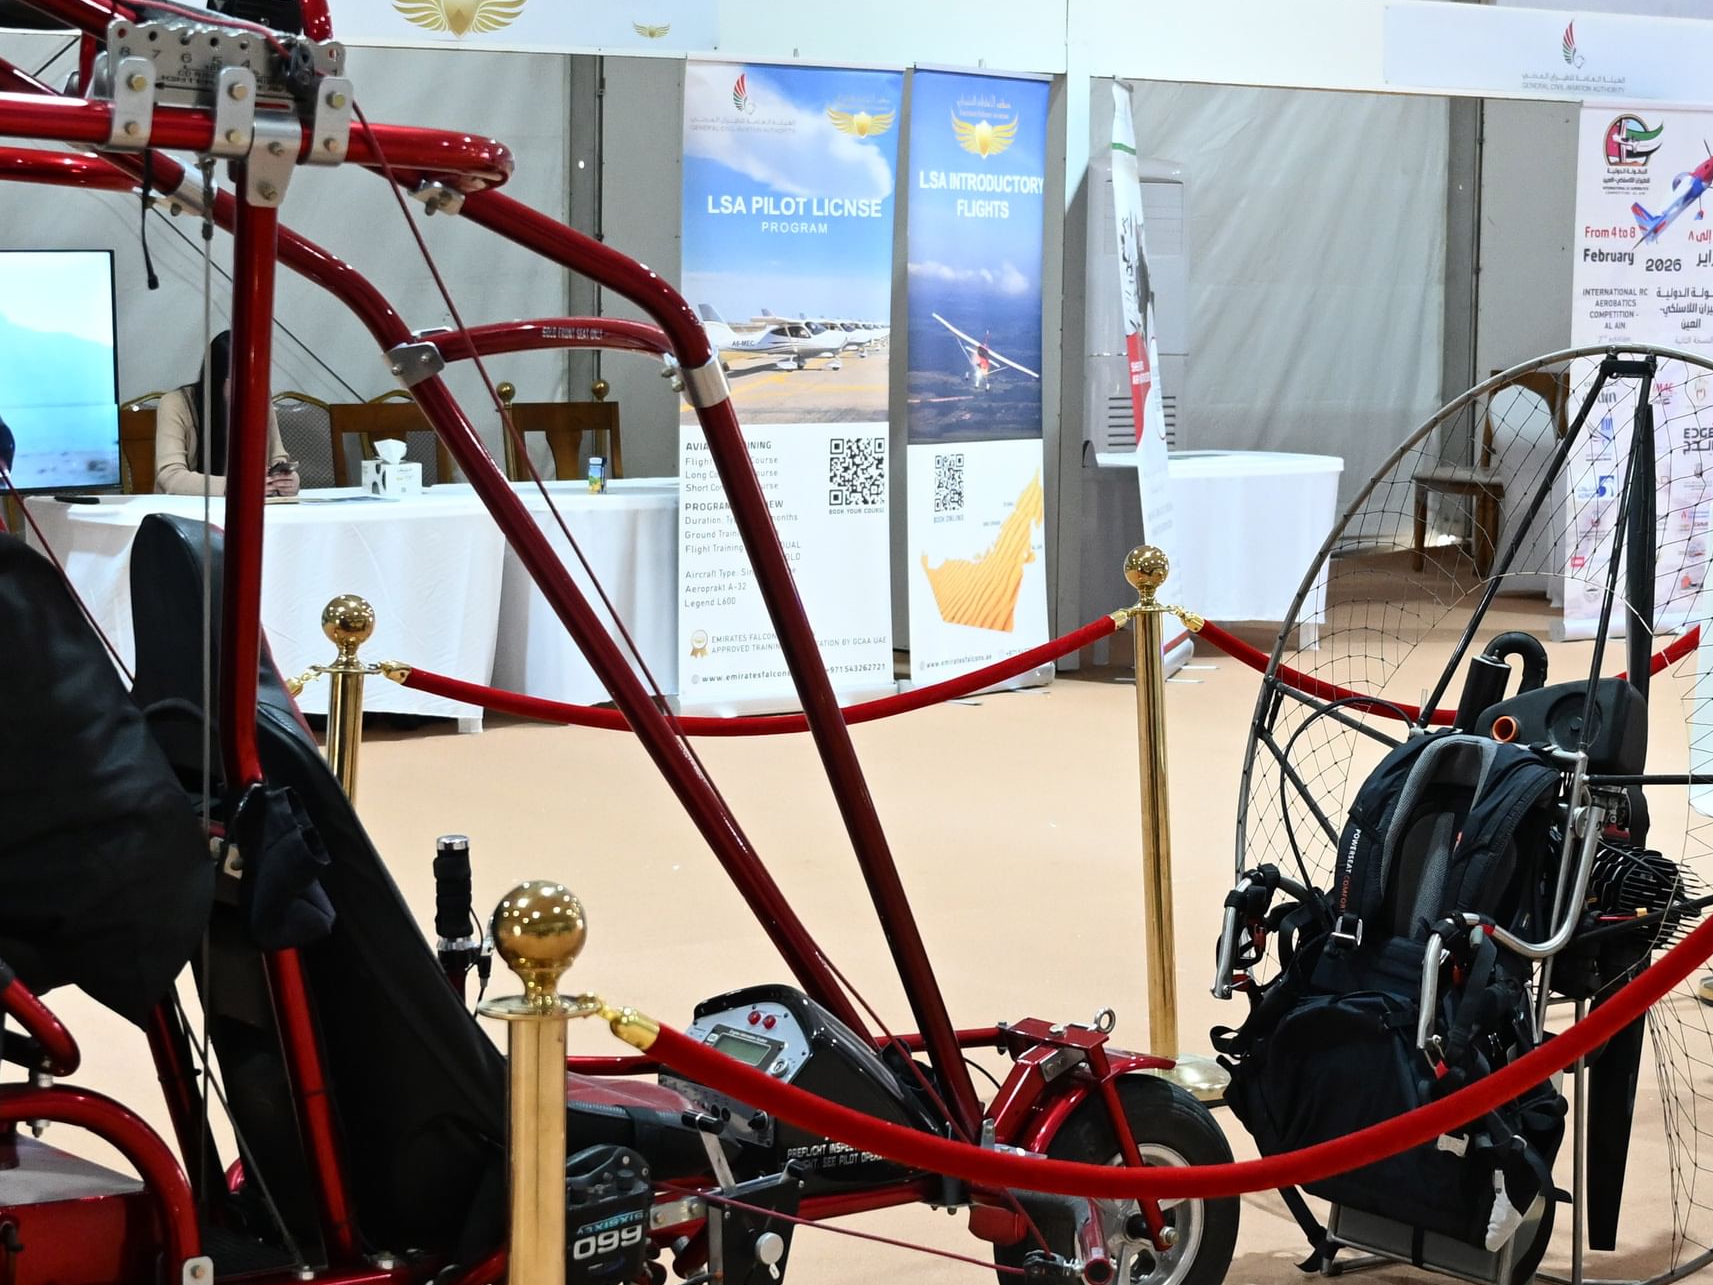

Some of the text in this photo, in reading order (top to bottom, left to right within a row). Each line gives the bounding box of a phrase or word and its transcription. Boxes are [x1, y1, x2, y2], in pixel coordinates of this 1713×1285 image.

[151, 49, 161, 59] 7
[181, 53, 192, 64] 6
[919, 170, 1045, 194] LSA INTRODUCTORY
[707, 195, 882, 218] LSA PILOT LICNSE
[956, 199, 1010, 218] FLIGHTS
[761, 221, 828, 234] PROGRAM
[1584, 226, 1636, 239] From 4 to 8
[1583, 248, 1682, 272] February 2026
[1582, 288, 1649, 296] INTERNATIONAL RC
[1655, 287, 1689, 300] الدولية
[1595, 299, 1637, 307] AEROBATICS
[1589, 310, 1634, 318] COMPETITION
[1681, 318, 1701, 330] العين
[685, 442, 710, 451] AVIA
[685, 458, 713, 468] Flight
[685, 471, 707, 481] Long
[685, 483, 709, 492] Short
[685, 530, 716, 539] Ground
[685, 544, 710, 555] Flight
[713, 543, 744, 553] Training
[685, 570, 717, 578] Aircraft
[685, 582, 747, 594] Aeroprakt A-32
[684, 597, 736, 609] Legend L600
[711, 633, 777, 644] EMIRATES FALCON
[842, 638, 851, 646] BY
[852, 637, 872, 646] GCAA
[873, 636, 887, 644] UAE
[711, 643, 781, 654] APPROVED TRAININ
[1345, 828, 1363, 874] POWERSEAT
[787, 1144, 827, 1159] PREFLIGHT
